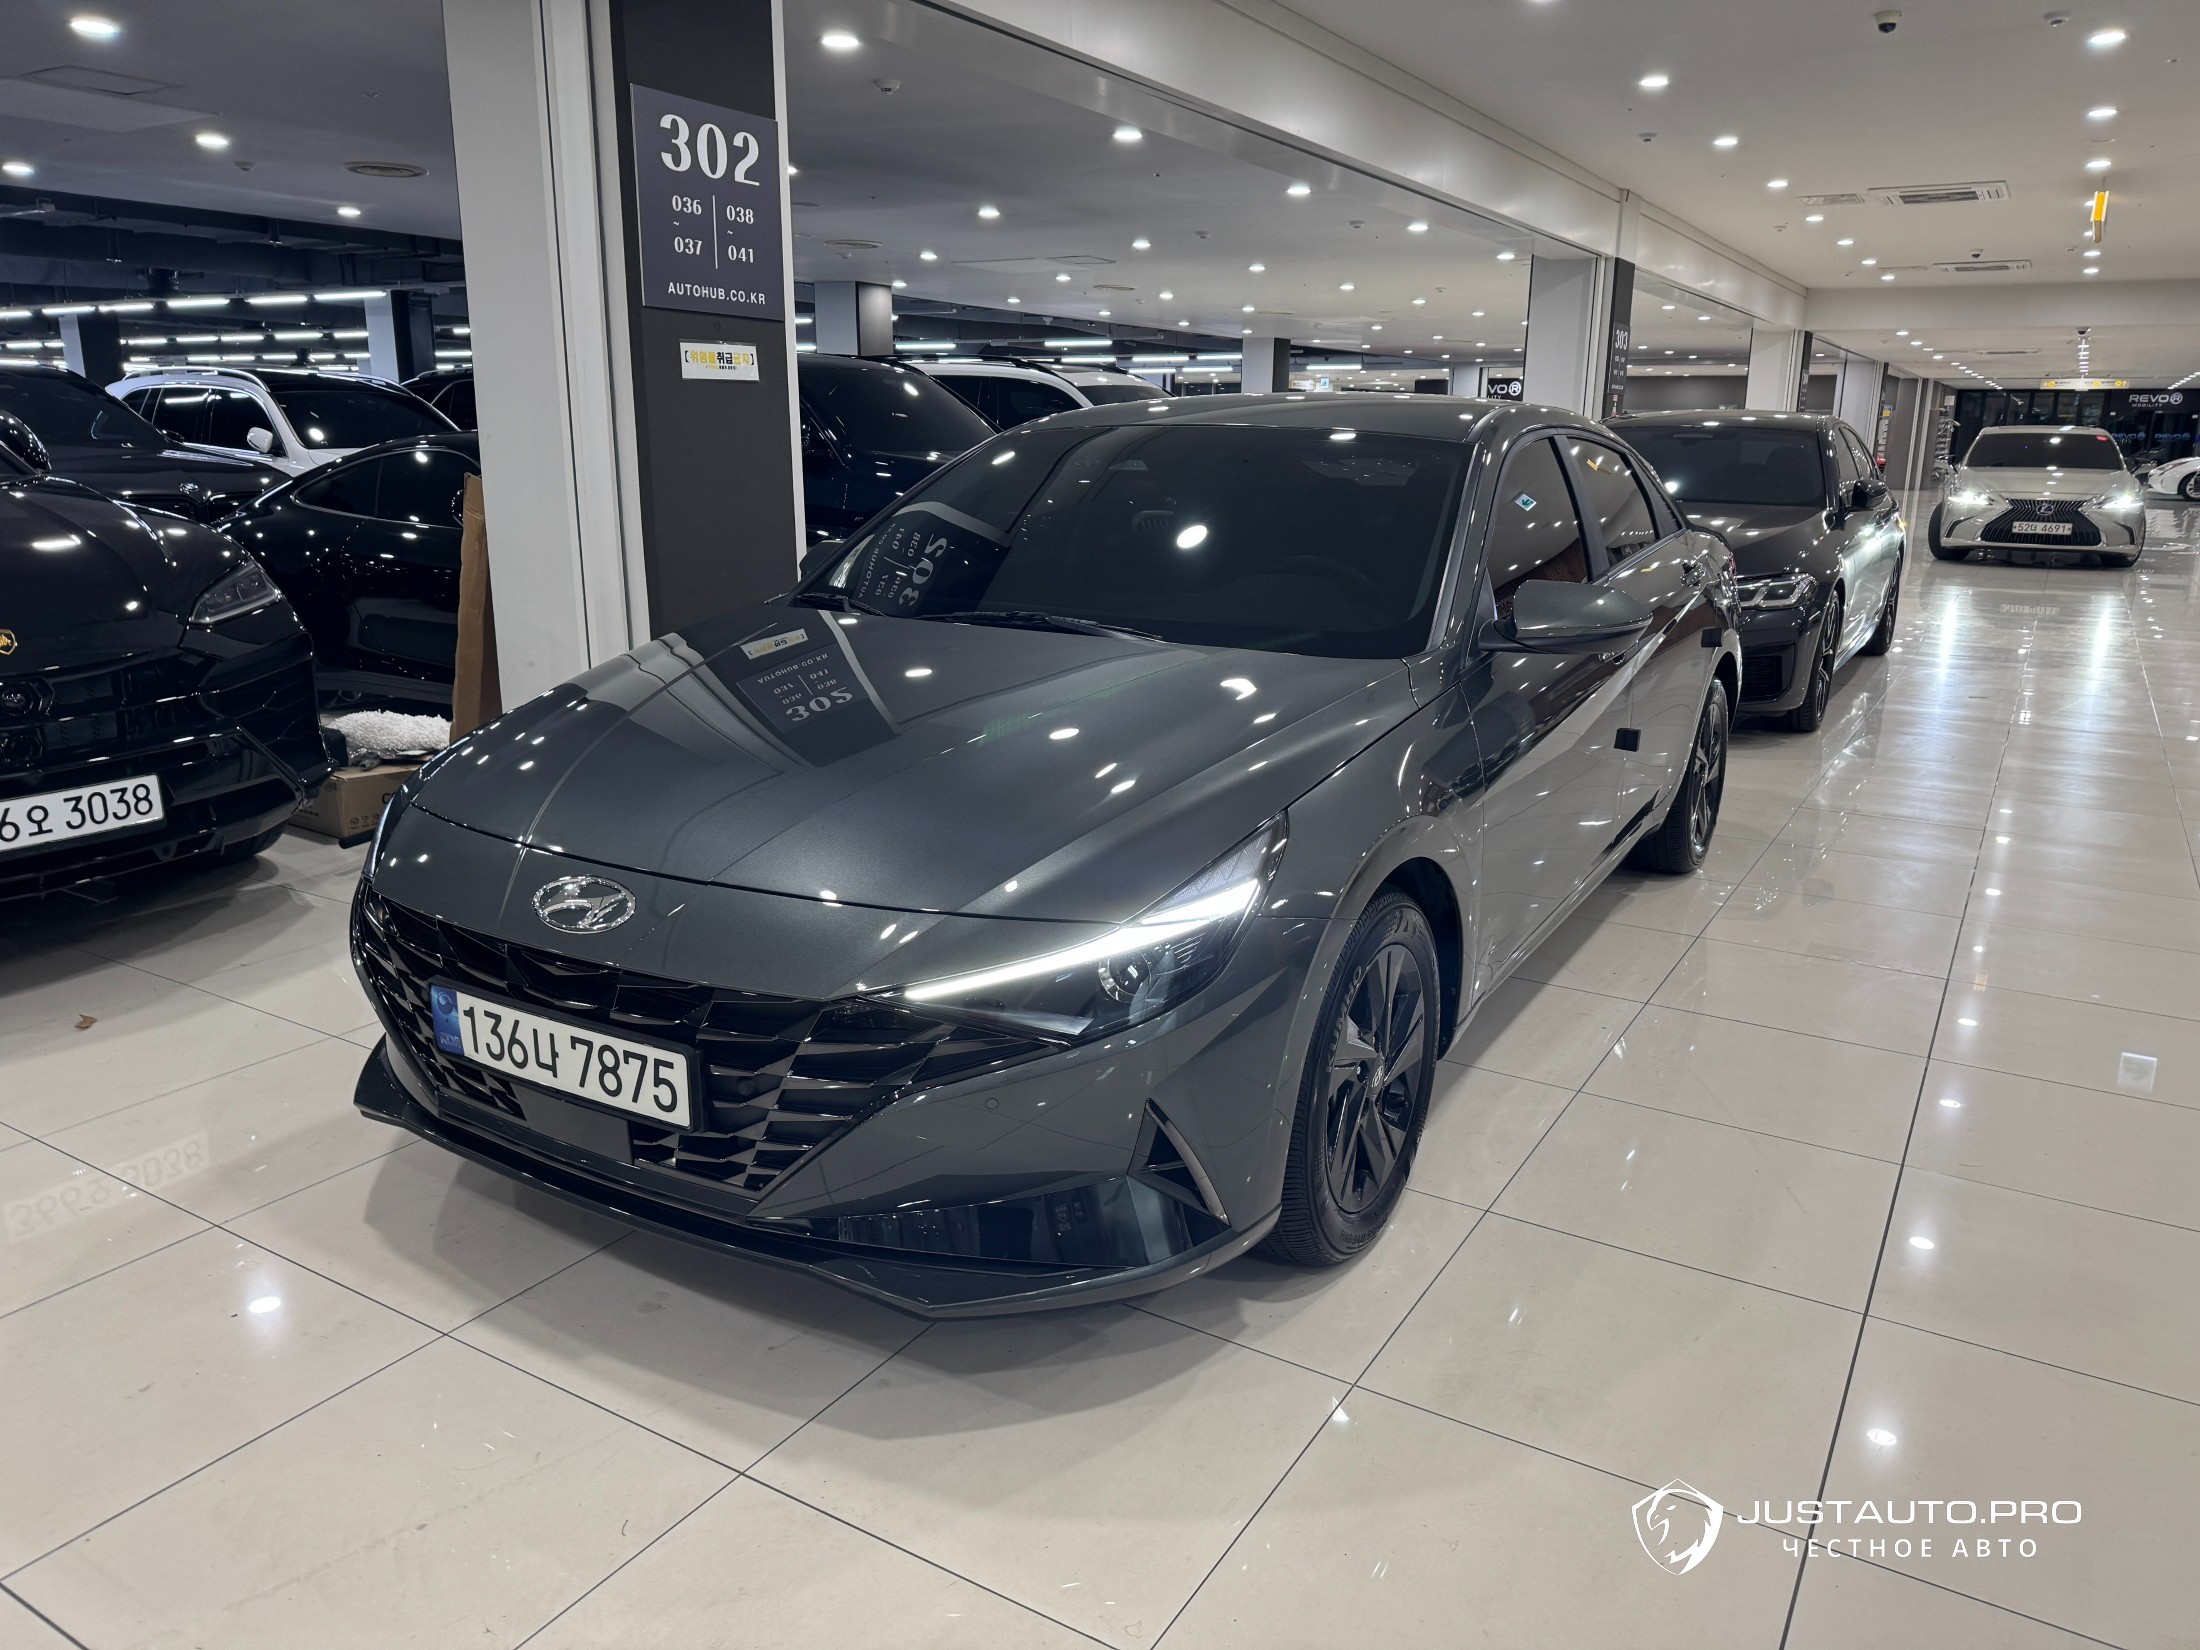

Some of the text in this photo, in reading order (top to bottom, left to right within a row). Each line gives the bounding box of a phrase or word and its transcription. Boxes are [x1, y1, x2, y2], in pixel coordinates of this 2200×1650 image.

[660, 114, 760, 186] 302
[671, 195, 702, 215] 036
[726, 205, 754, 224] 038
[674, 236, 702, 255] 037
[728, 245, 754, 263] 041
[668, 282, 766, 305] AUTOHUB.CO.KR
[1615, 329, 1629, 350] 303
[2041, 524, 2066, 533] 4691
[63, 783, 153, 830] 3038
[463, 1006, 678, 1113] 136나 7875
